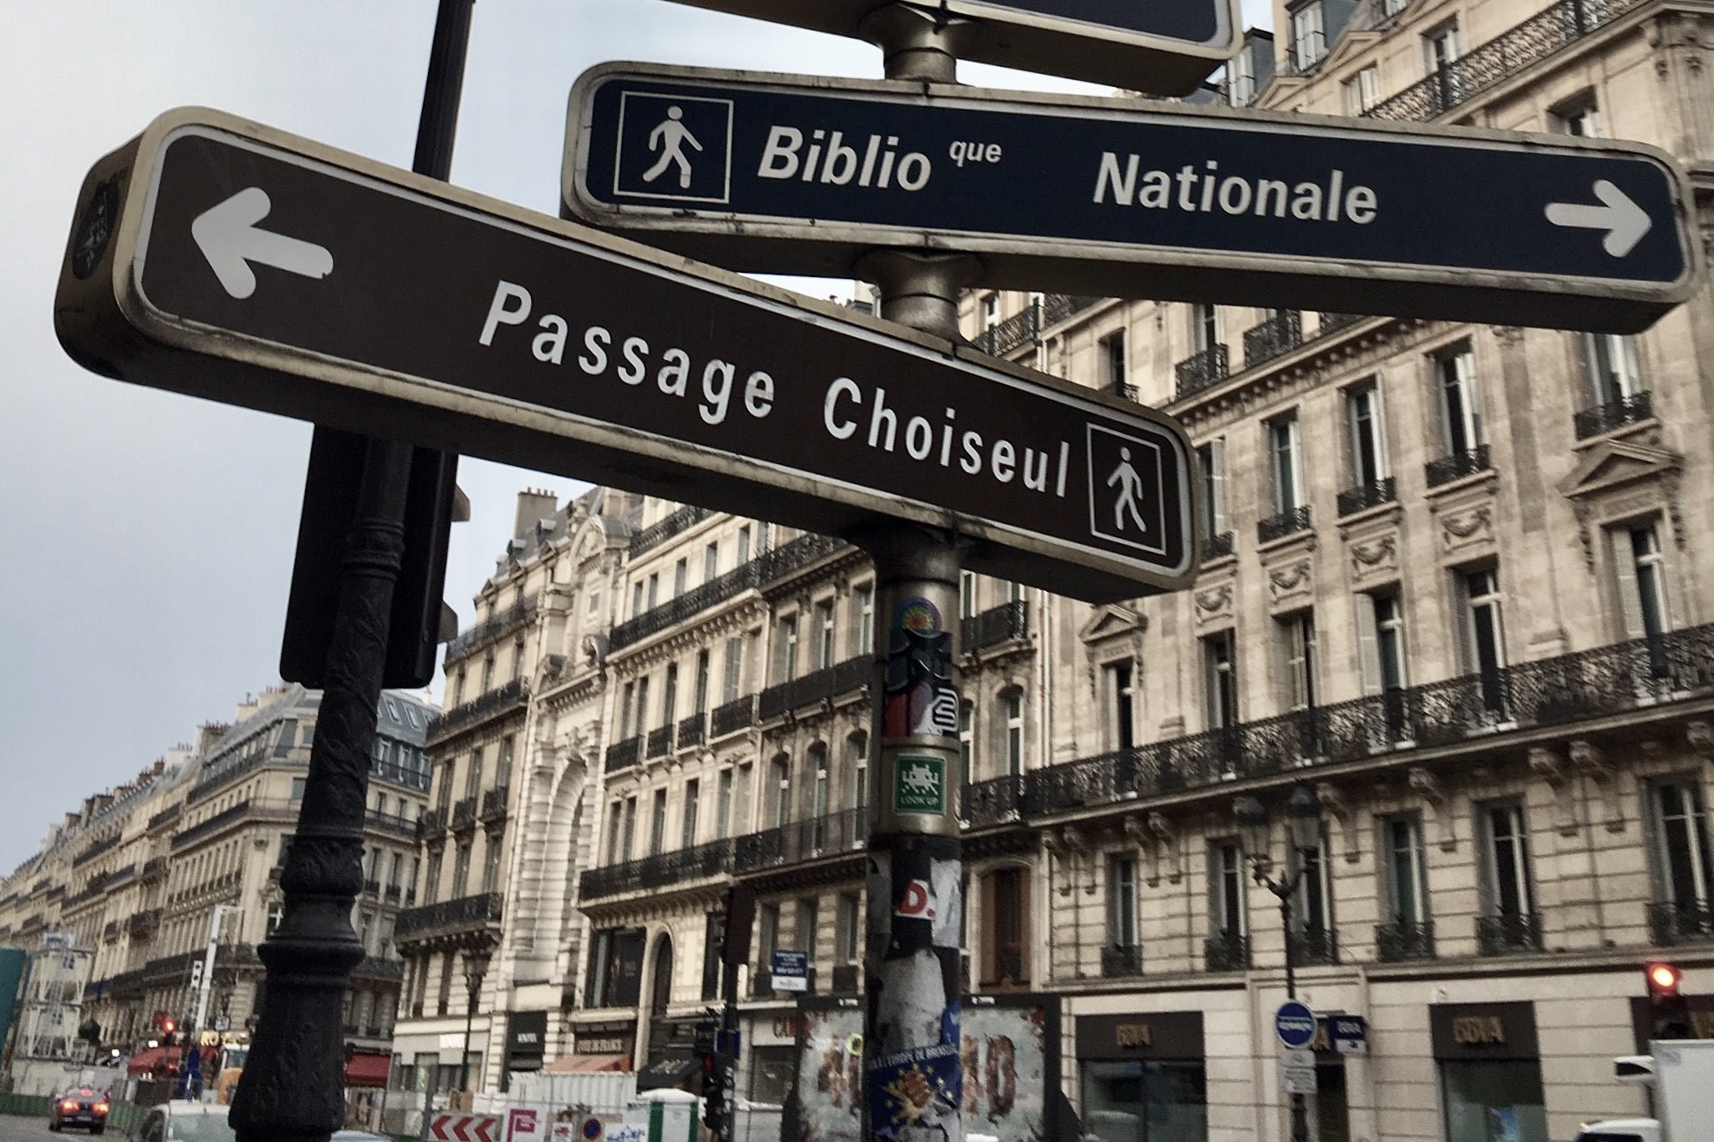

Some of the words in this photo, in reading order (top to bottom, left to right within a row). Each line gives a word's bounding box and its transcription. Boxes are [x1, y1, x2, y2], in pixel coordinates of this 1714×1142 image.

[757, 125, 931, 191] Biblio
[949, 141, 1002, 167] que
[1093, 151, 1377, 224] Nationale
[478, 280, 774, 425] Passage
[824, 377, 1069, 497] Choiseul
